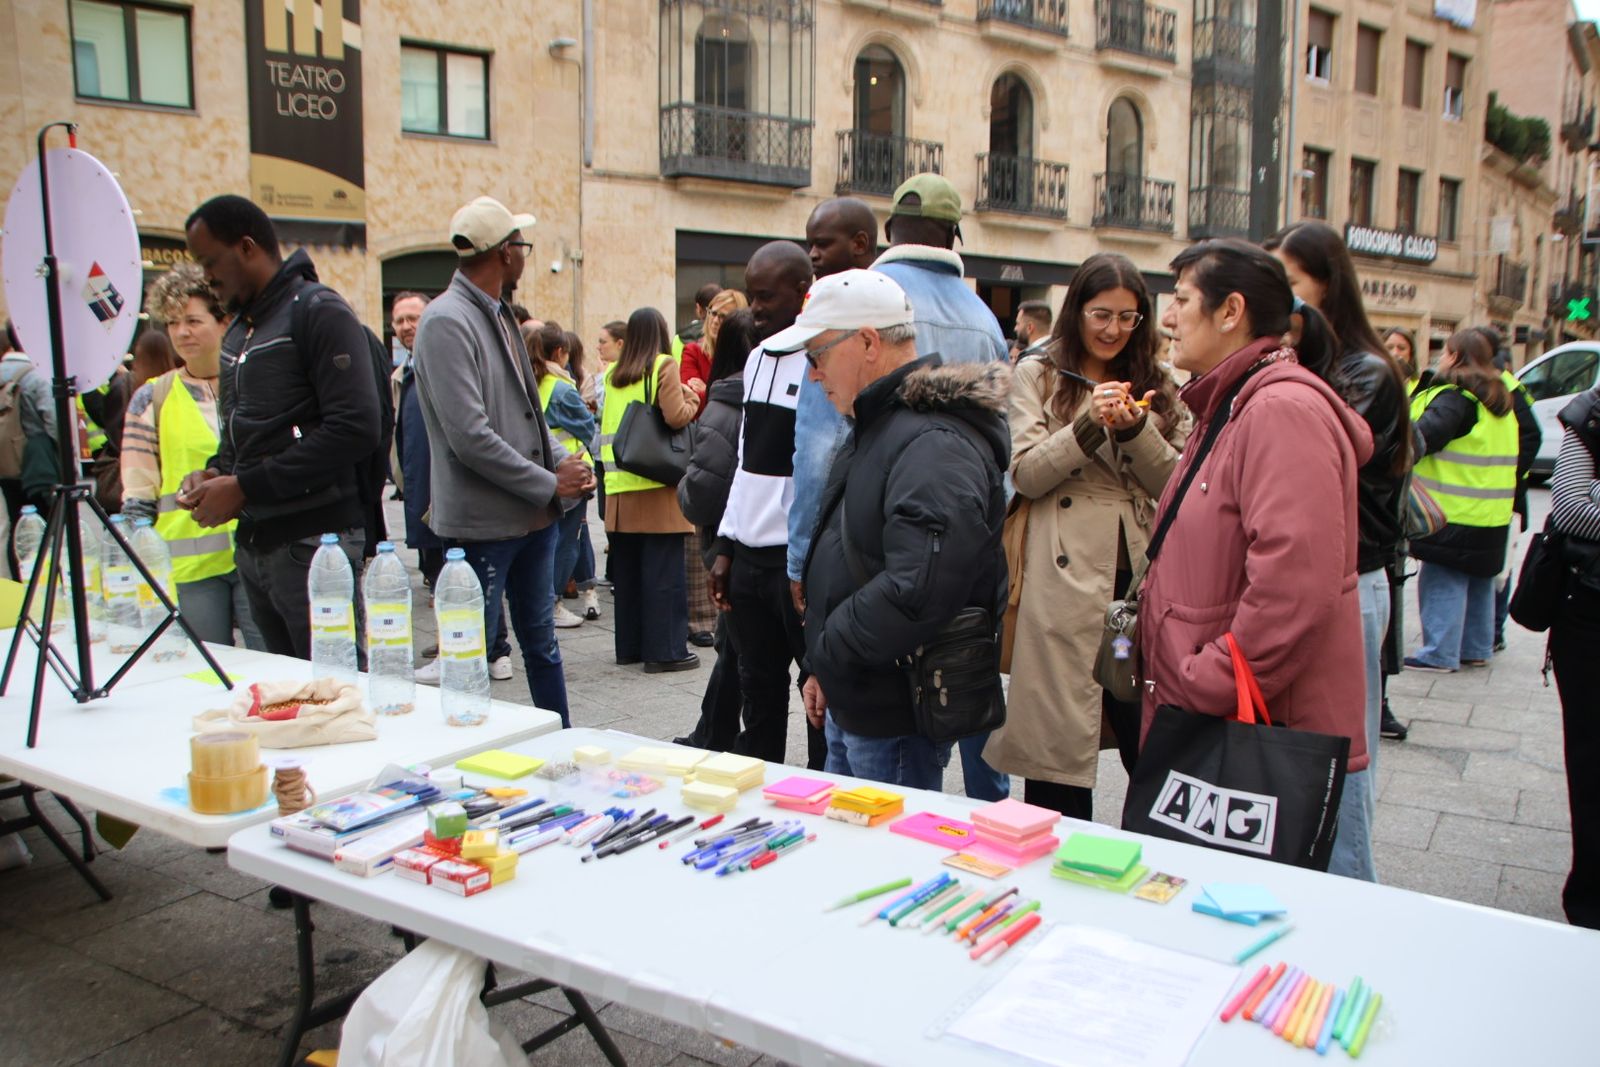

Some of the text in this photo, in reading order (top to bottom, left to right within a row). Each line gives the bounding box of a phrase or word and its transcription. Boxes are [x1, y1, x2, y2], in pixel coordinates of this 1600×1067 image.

[265, 60, 345, 93] TEATRO
[277, 91, 337, 120] LICEO
[1347, 226, 1437, 260] FOTOCOPIAS CALCO
